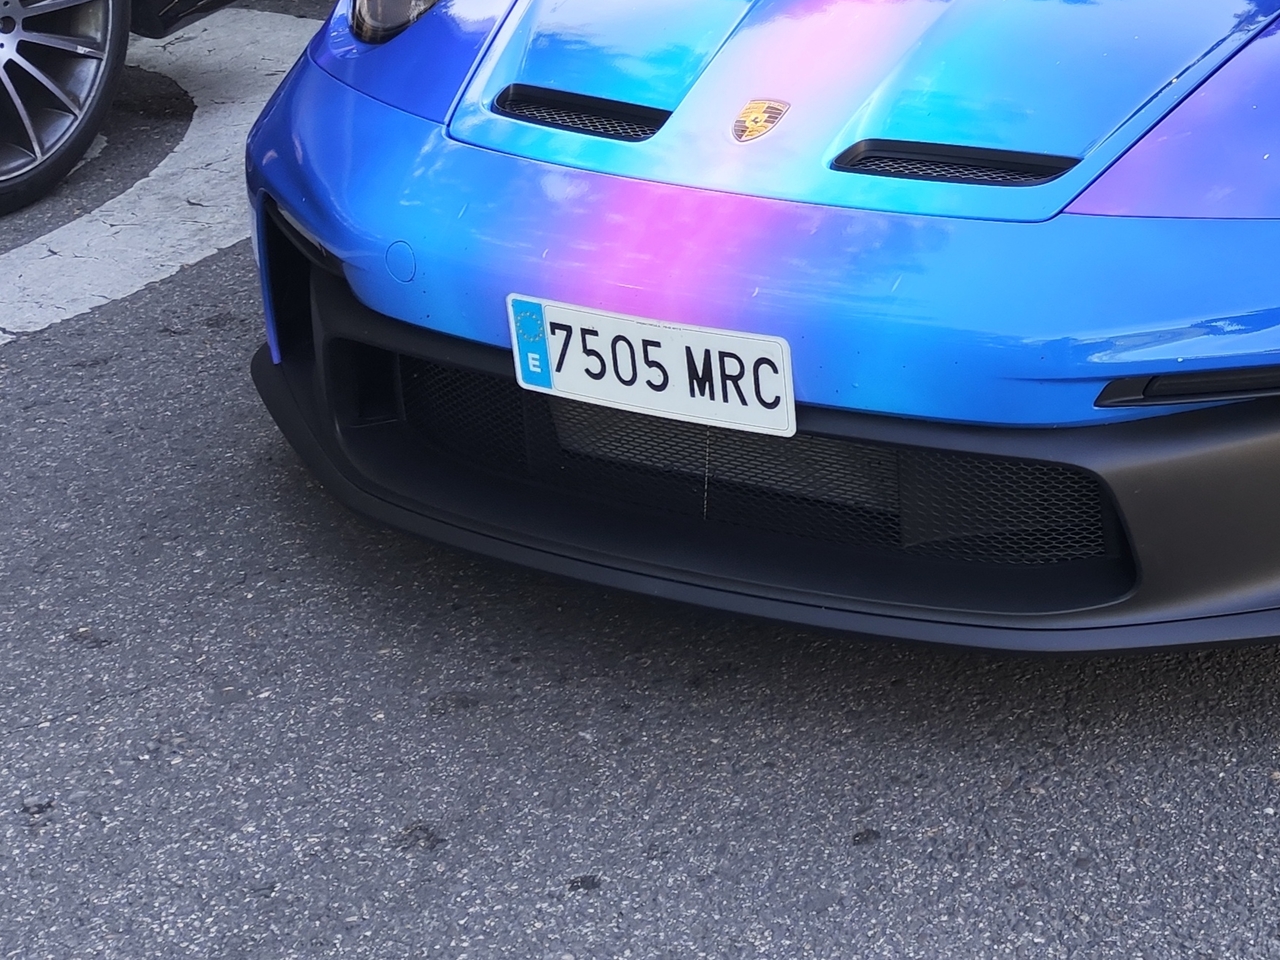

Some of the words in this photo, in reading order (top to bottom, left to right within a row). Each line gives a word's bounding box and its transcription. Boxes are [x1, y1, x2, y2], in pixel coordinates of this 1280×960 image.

[527, 352, 541, 373] E
[549, 321, 669, 392] 7505
[685, 345, 781, 410] MRC
